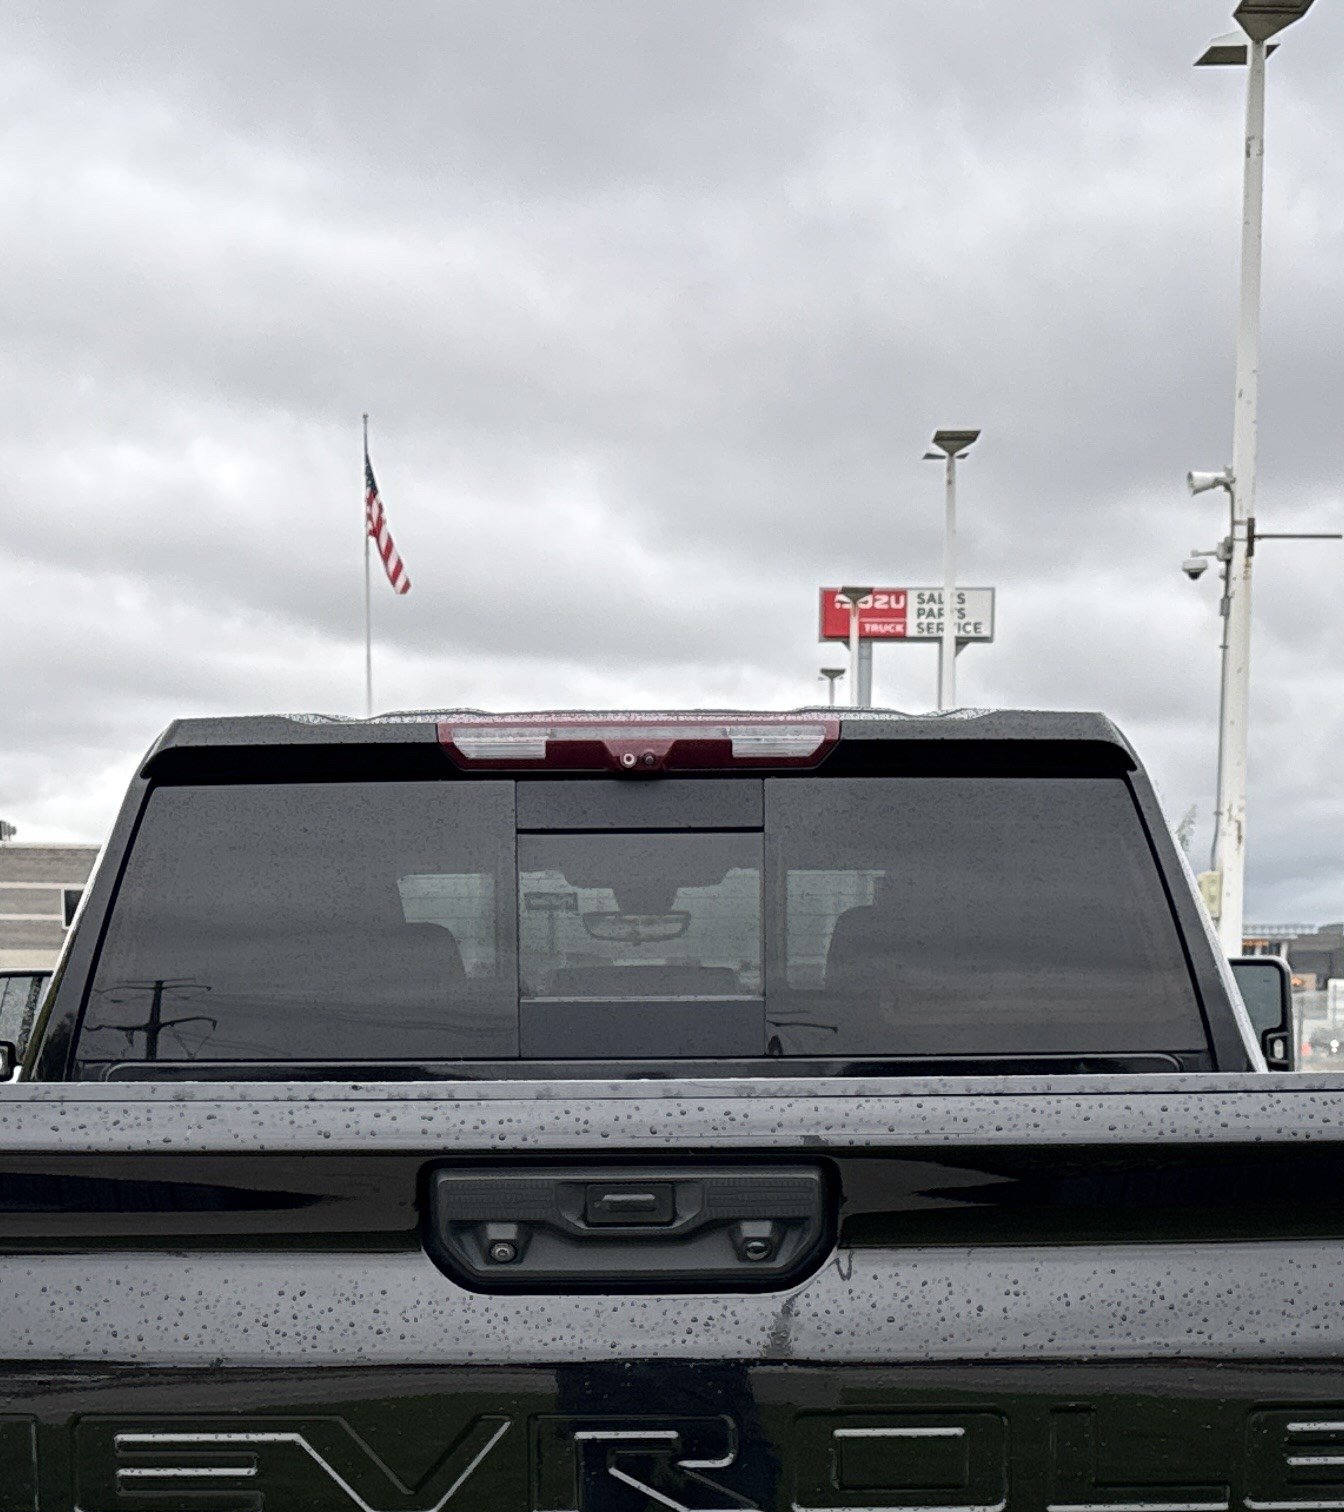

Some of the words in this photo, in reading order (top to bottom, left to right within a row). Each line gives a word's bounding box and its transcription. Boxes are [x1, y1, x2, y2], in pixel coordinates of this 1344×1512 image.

[917, 592, 966, 605] SALS
[917, 608, 966, 620] PARS
[864, 624, 905, 634] TRUCK
[917, 622, 983, 635] SERICE
